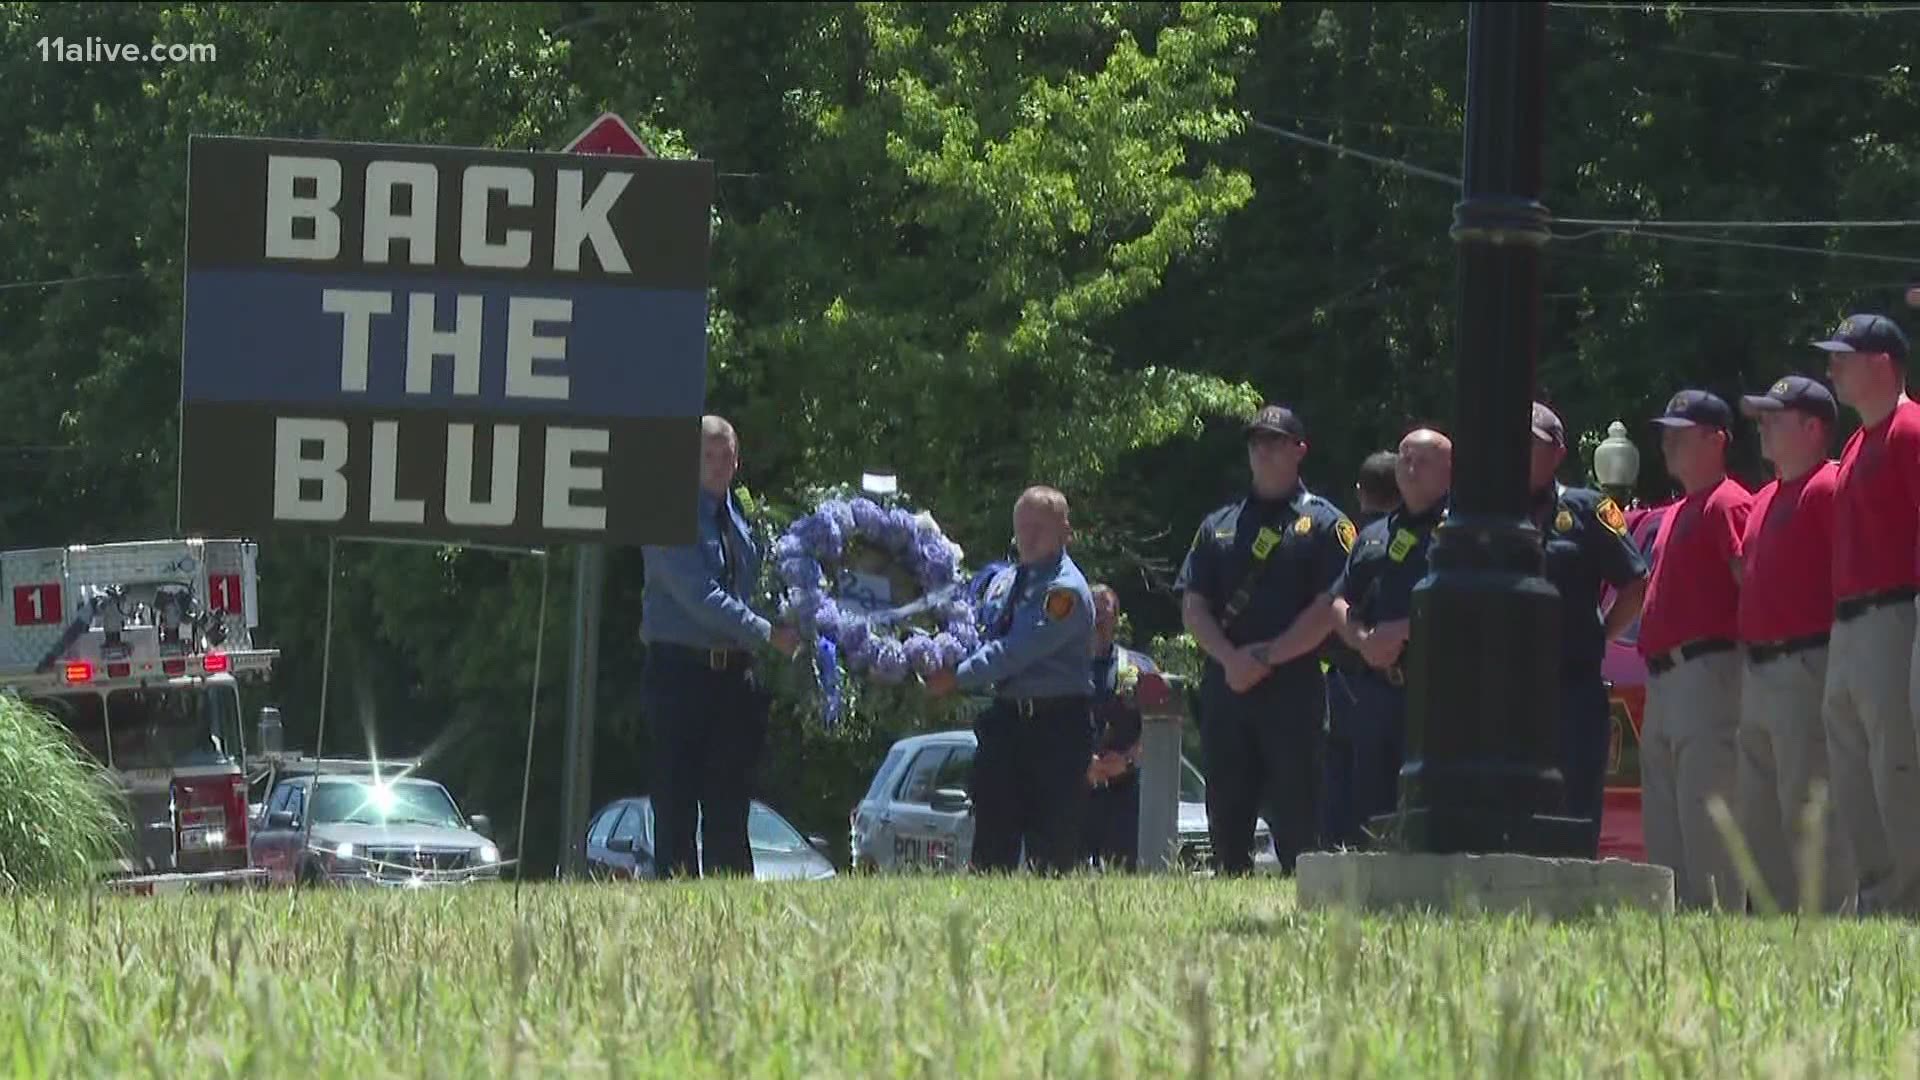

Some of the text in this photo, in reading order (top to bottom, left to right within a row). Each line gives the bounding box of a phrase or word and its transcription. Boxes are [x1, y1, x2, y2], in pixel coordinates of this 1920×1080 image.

[264, 154, 635, 274] BACK
[321, 288, 574, 400] THE
[272, 416, 610, 530] BLUE
[28, 587, 42, 620] 1
[219, 578, 230, 610] 1
[894, 837, 956, 866] POLICE
